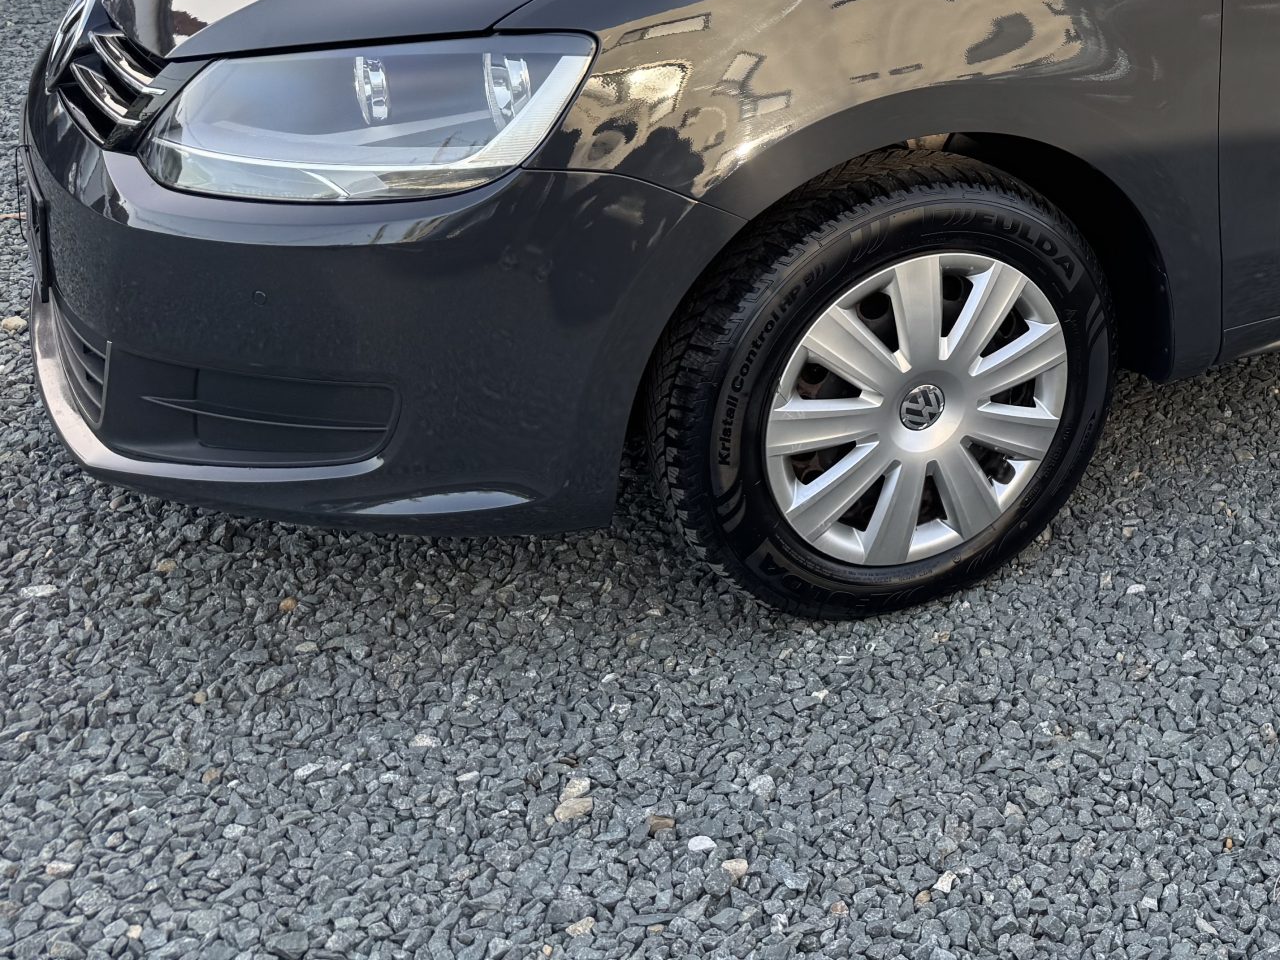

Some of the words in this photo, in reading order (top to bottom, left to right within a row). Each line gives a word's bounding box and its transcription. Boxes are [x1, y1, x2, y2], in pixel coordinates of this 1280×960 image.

[982, 213, 1075, 282] FULDA
[717, 395, 740, 466] Kristall
[733, 311, 780, 393] Control
